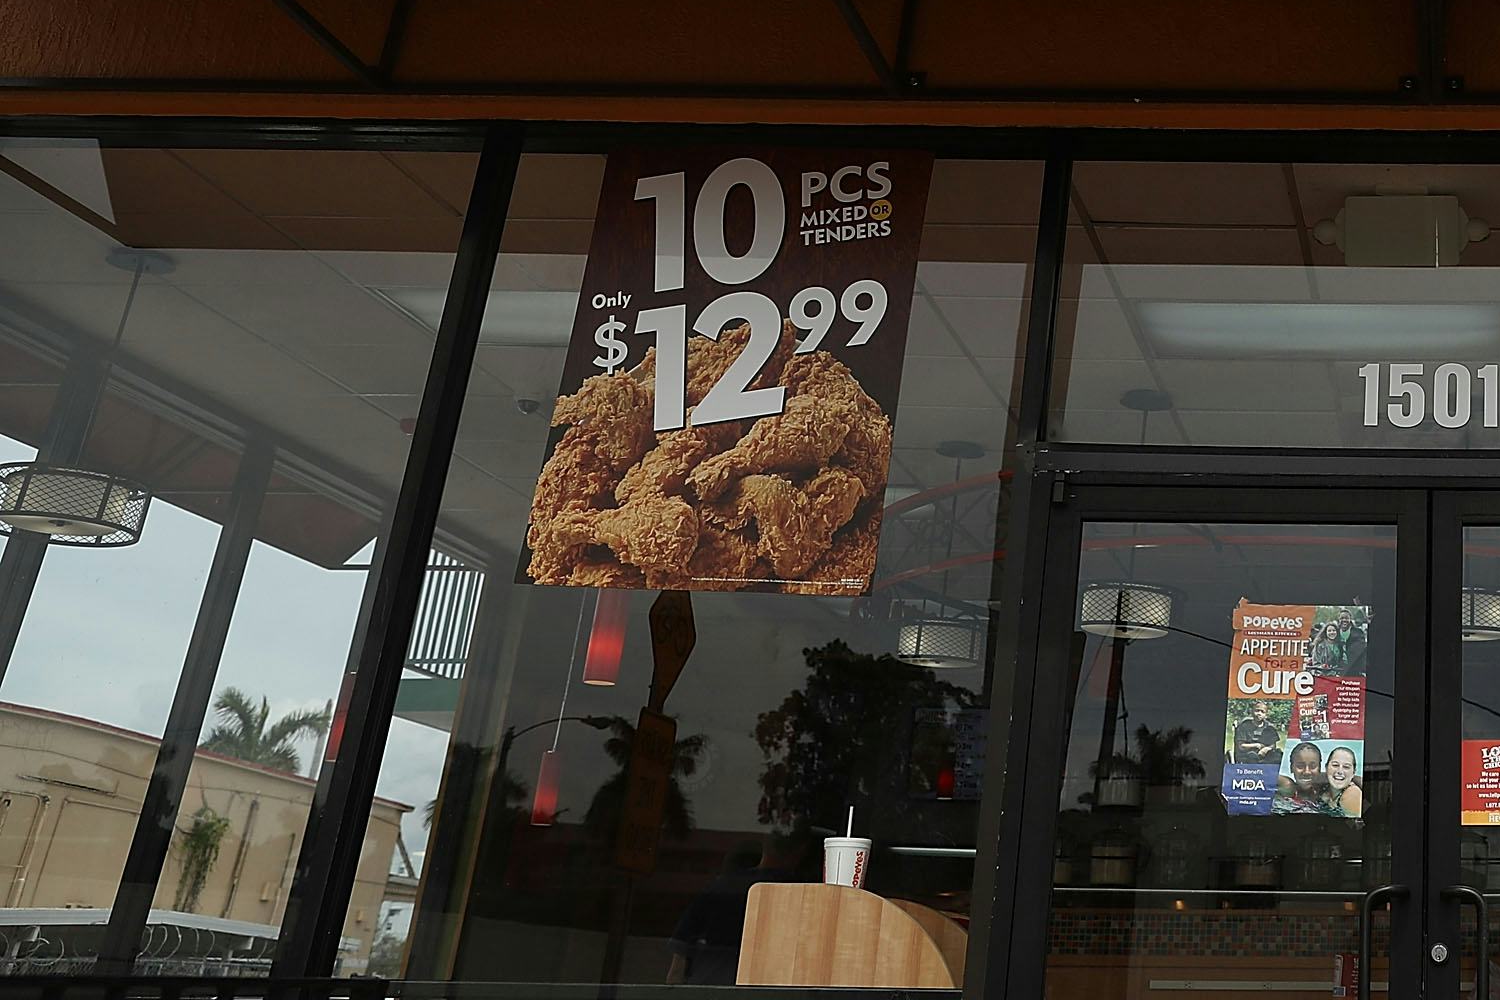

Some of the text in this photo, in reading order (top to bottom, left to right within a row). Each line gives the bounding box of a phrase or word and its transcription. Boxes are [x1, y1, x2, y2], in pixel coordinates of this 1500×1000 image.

[801, 161, 892, 208] PCS
[633, 157, 786, 293] 10
[800, 204, 890, 228] MIXED OR
[799, 220, 892, 246] TENDERS
[591, 290, 632, 310] Only
[1358, 362, 1499, 429] 1501
[1240, 638, 1310, 656] APPETITE
[1264, 656, 1299, 670] for a
[1237, 662, 1314, 696] Cure
[1232, 779, 1266, 791] MDA
